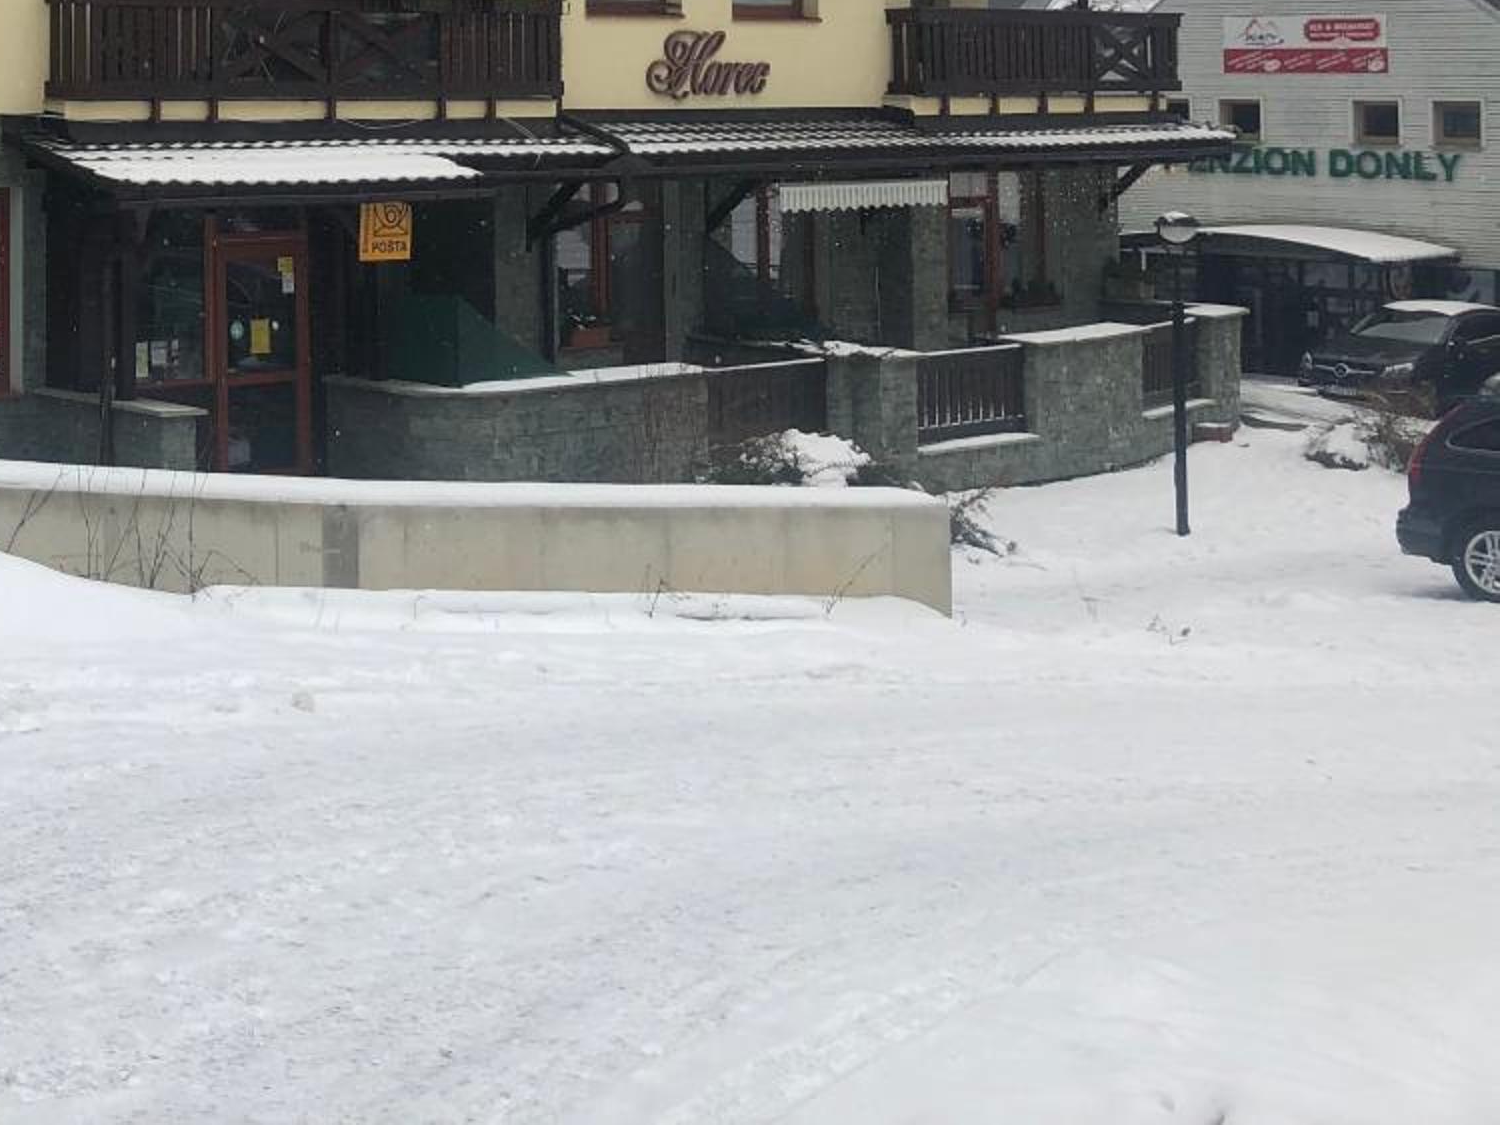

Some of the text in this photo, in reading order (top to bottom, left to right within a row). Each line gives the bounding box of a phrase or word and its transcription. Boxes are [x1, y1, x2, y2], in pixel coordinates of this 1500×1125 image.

[1186, 147, 1460, 182] NZION DONLY
[371, 240, 408, 253] POŠTA
